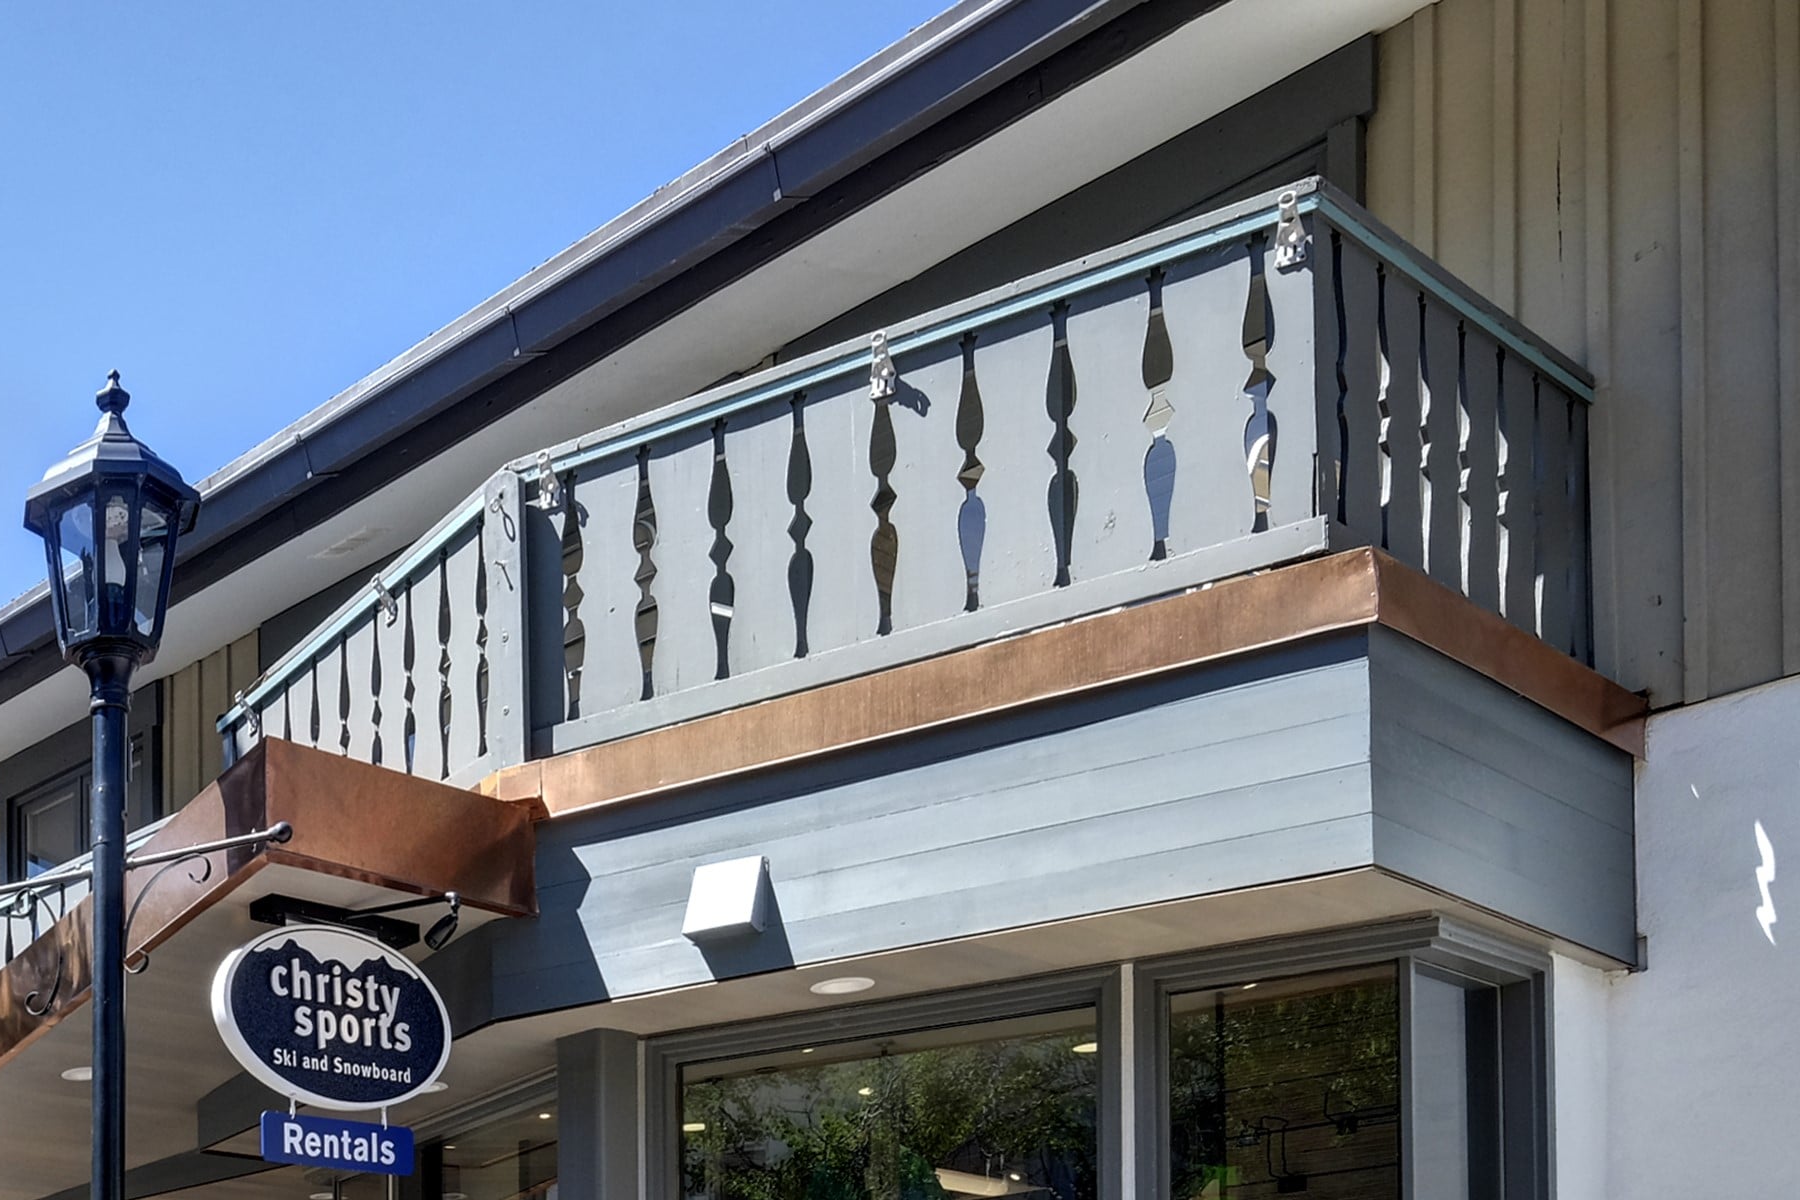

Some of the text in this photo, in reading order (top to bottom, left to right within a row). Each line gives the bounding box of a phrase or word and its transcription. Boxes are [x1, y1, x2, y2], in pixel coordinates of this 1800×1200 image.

[270, 957, 400, 1028] christy
[294, 1004, 412, 1052] sports
[273, 1048, 412, 1084] Ski and Snowboard
[283, 1122, 396, 1165] Rentals
